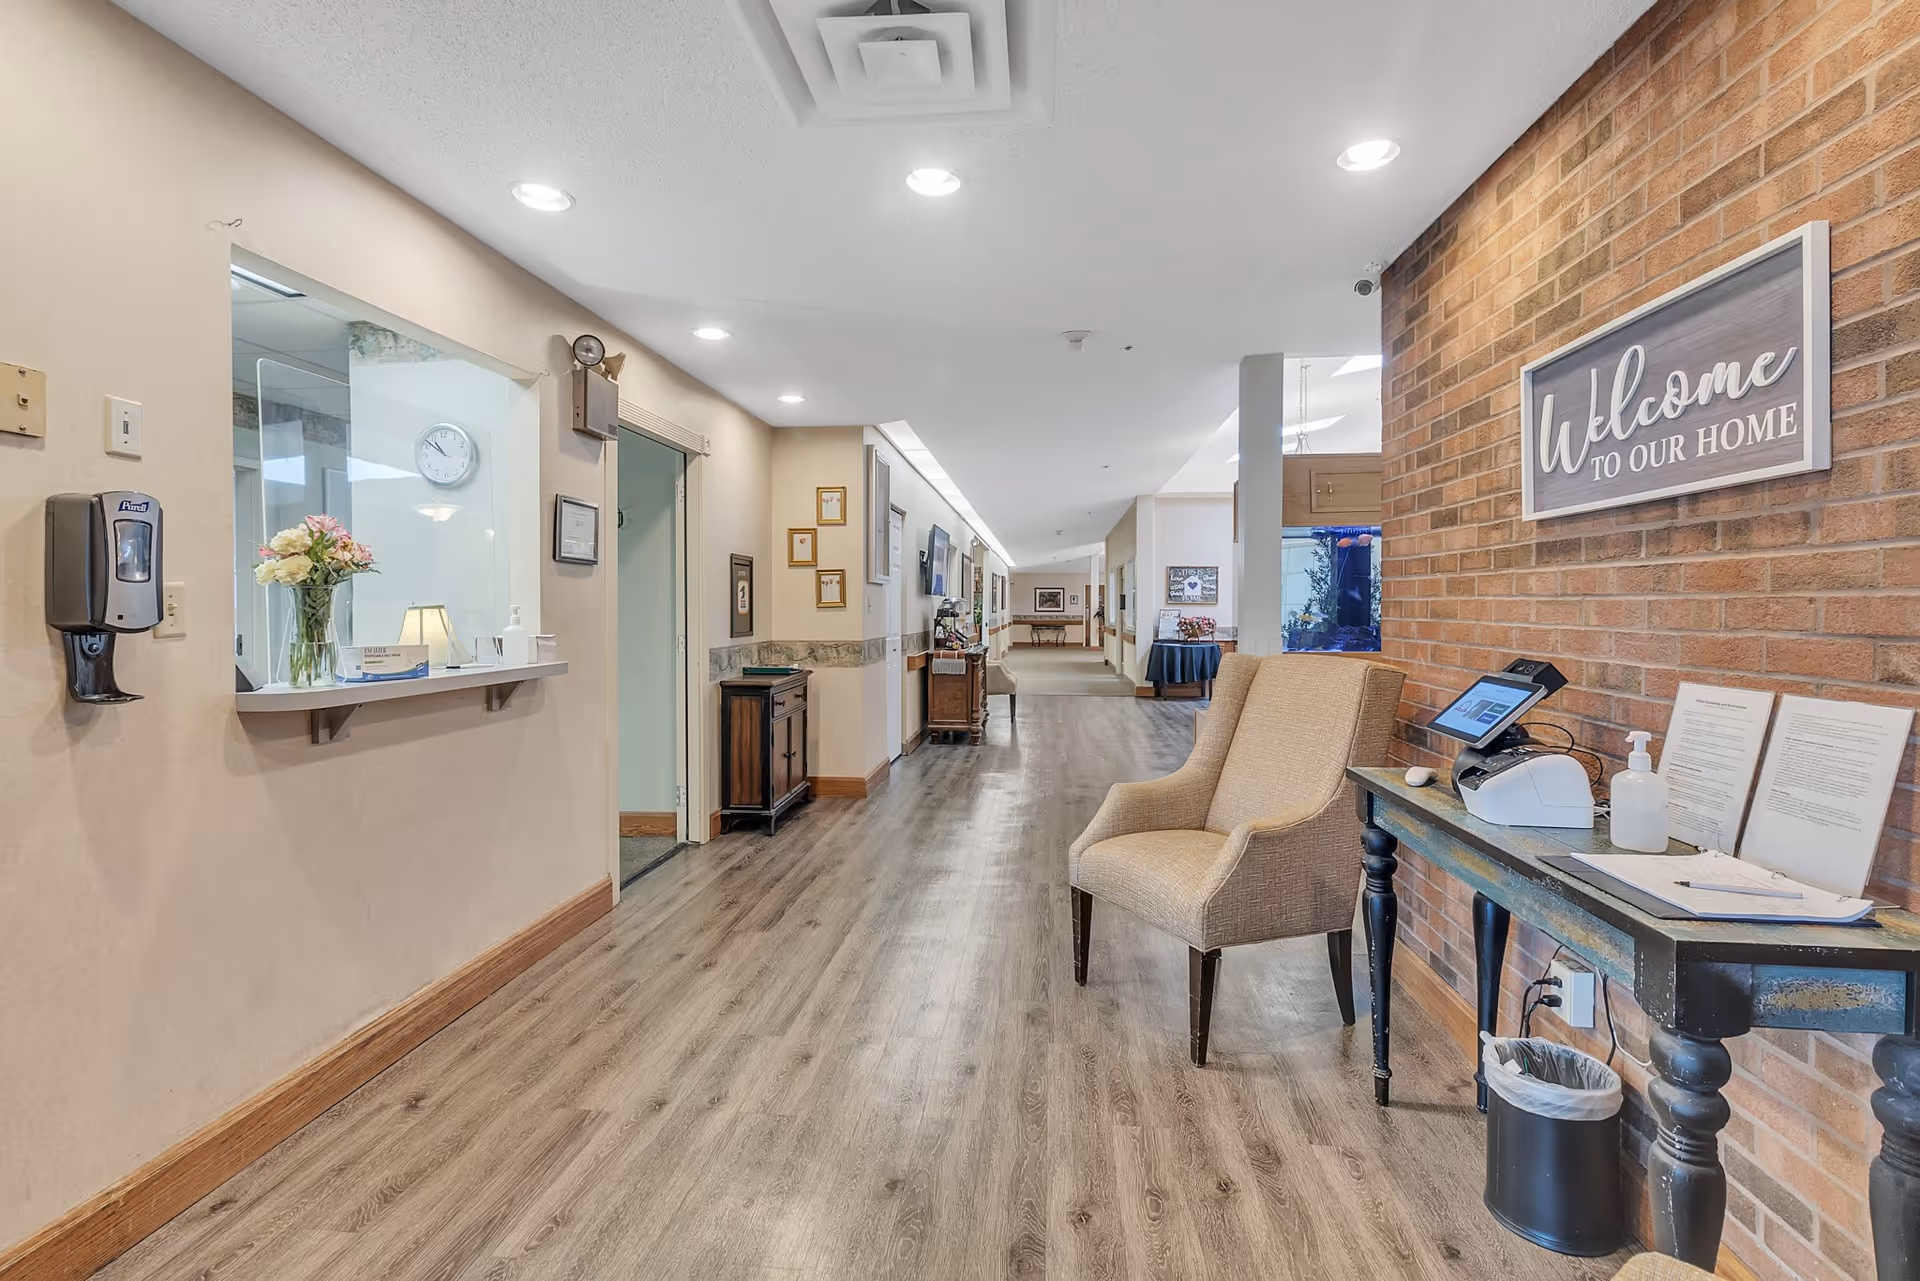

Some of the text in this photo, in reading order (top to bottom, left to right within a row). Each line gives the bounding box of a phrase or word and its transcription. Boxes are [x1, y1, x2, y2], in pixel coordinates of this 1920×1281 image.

[1540, 344, 1799, 474] Welcome
[1591, 402, 1799, 481] TO OUR HOME
